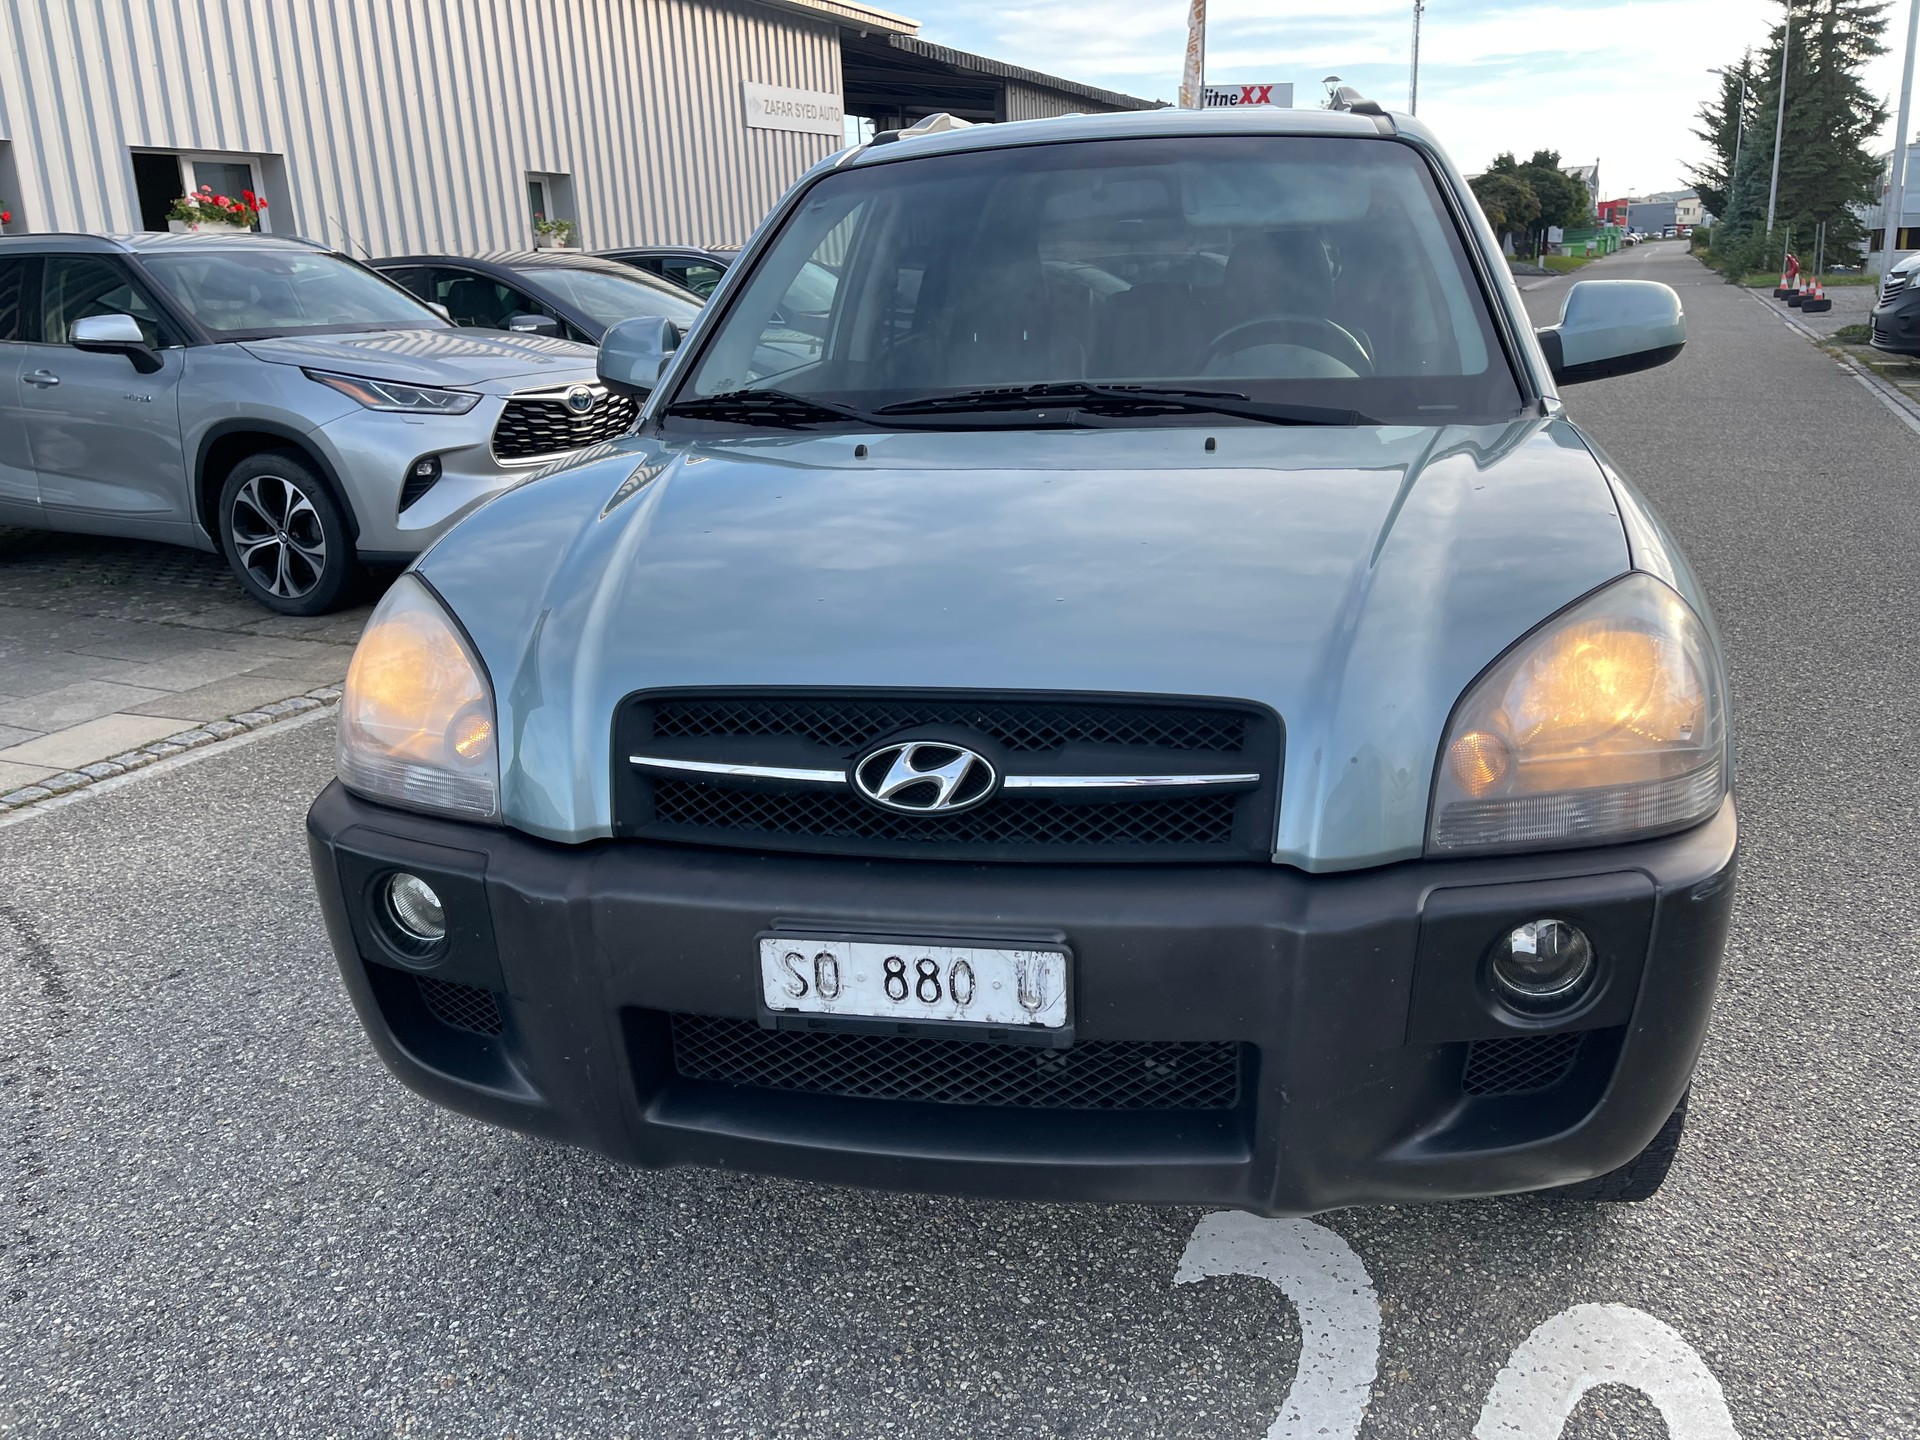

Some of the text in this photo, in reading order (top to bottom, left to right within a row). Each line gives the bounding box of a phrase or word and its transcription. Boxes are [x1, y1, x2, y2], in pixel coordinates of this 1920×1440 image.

[764, 99, 841, 122] ZAFAR SYED AUTO
[783, 951, 1045, 1012] SO 880 U
